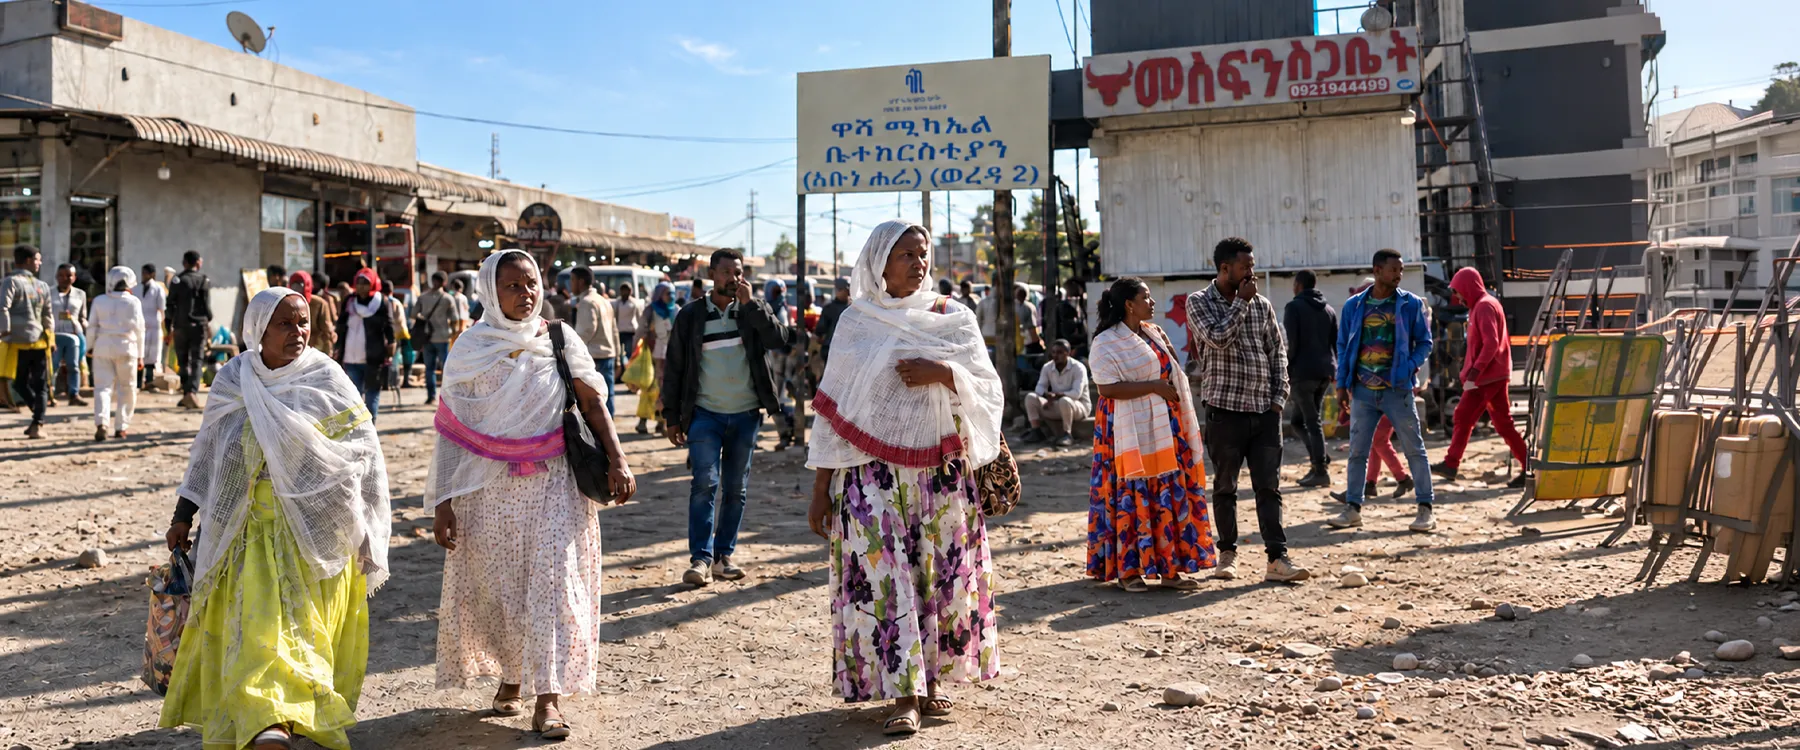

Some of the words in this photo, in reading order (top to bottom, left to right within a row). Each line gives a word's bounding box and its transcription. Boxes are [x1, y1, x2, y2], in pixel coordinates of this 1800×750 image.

[1290, 78, 1387, 97] 0921944499
[831, 118, 873, 138] ዋሻ
[930, 167, 1002, 188] (ወረዳ
[1013, 165, 1039, 186] 2)
